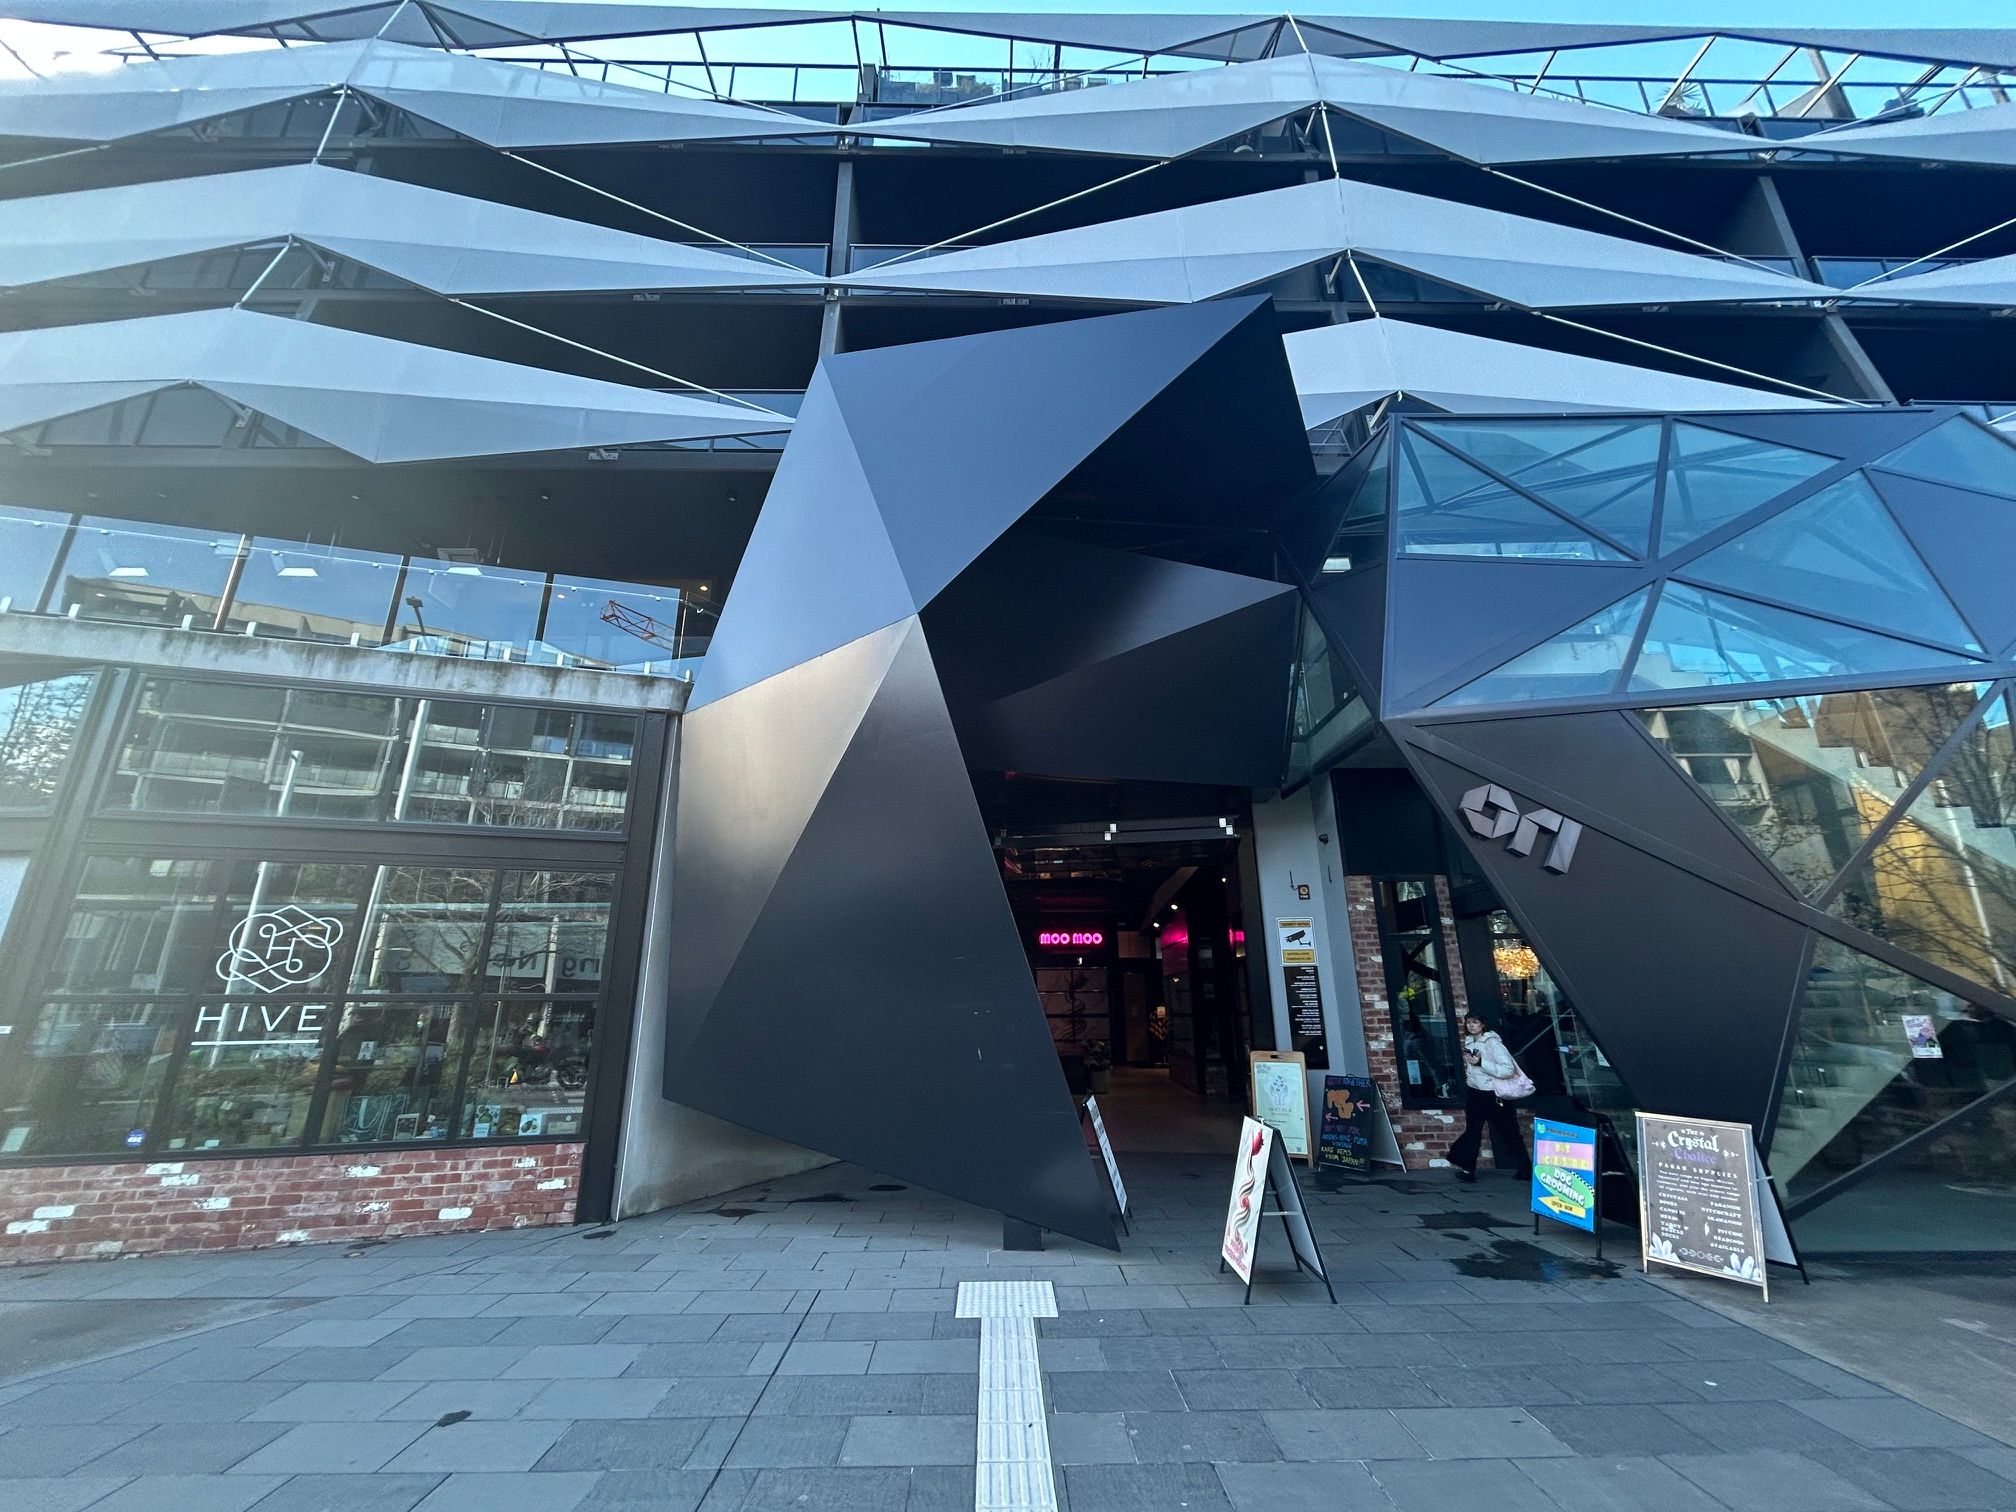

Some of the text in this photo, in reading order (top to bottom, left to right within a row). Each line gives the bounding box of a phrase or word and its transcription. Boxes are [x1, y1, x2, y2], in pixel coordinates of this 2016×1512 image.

[195, 1005, 326, 1032] HIVE
[1668, 1131, 1719, 1152] Crystal
[1540, 1172, 1584, 1205] GROOMING
[1554, 1168, 1572, 1188] DOG
